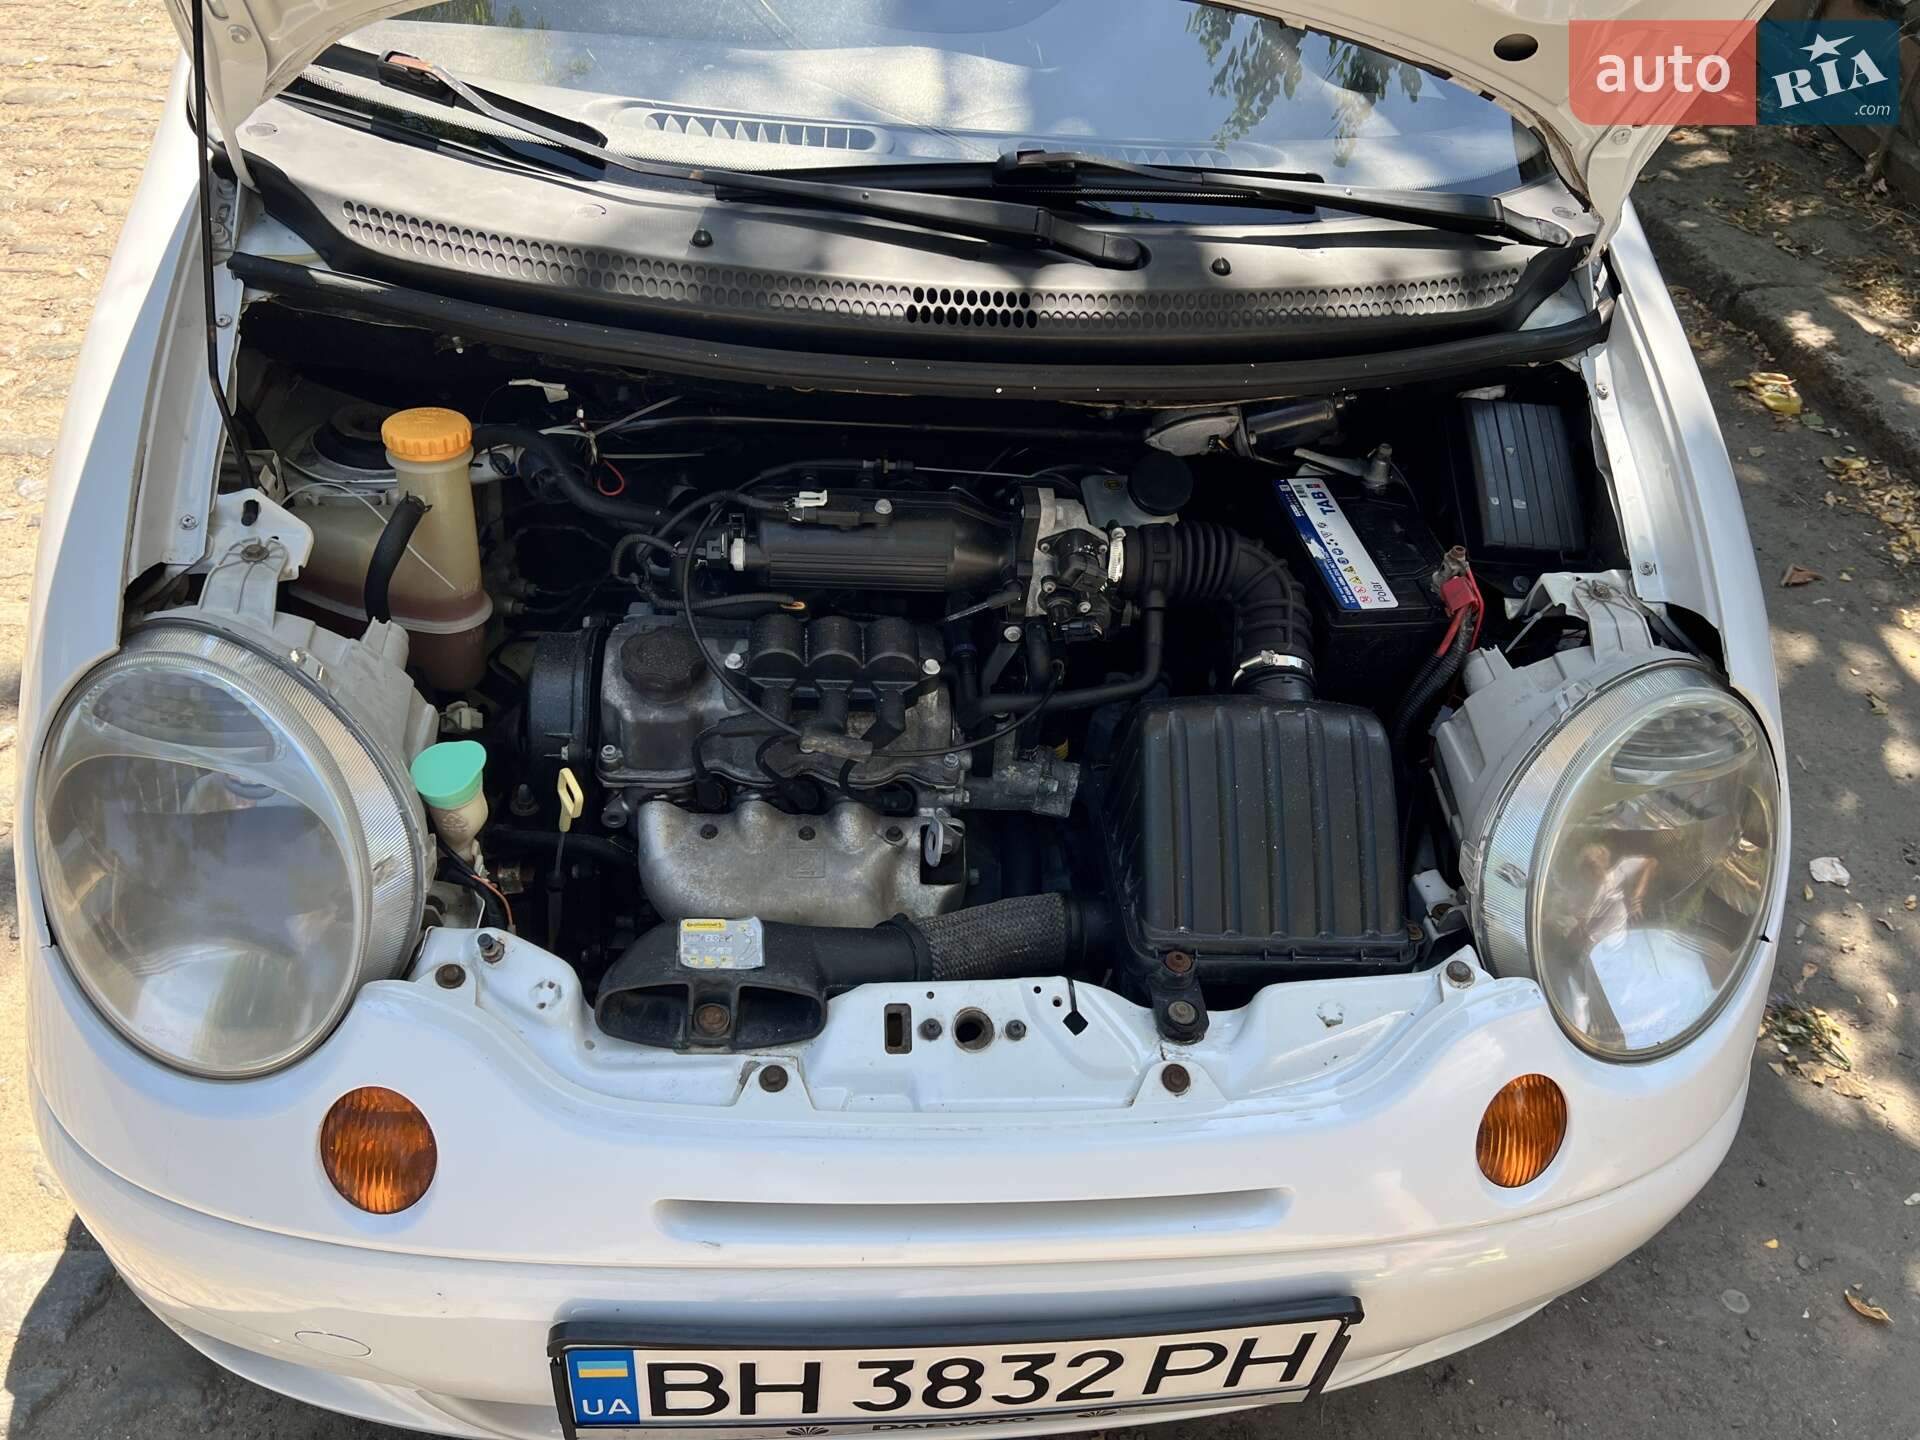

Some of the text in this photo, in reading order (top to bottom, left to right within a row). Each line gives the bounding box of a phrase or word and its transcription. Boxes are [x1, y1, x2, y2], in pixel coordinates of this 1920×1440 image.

[1311, 491, 1336, 516] TAB
[1371, 581, 1391, 602] Polar
[647, 1332, 1317, 1416] BH 3832 PH
[582, 1398, 632, 1415] UA
[872, 1417, 1034, 1431] DAEWOO
